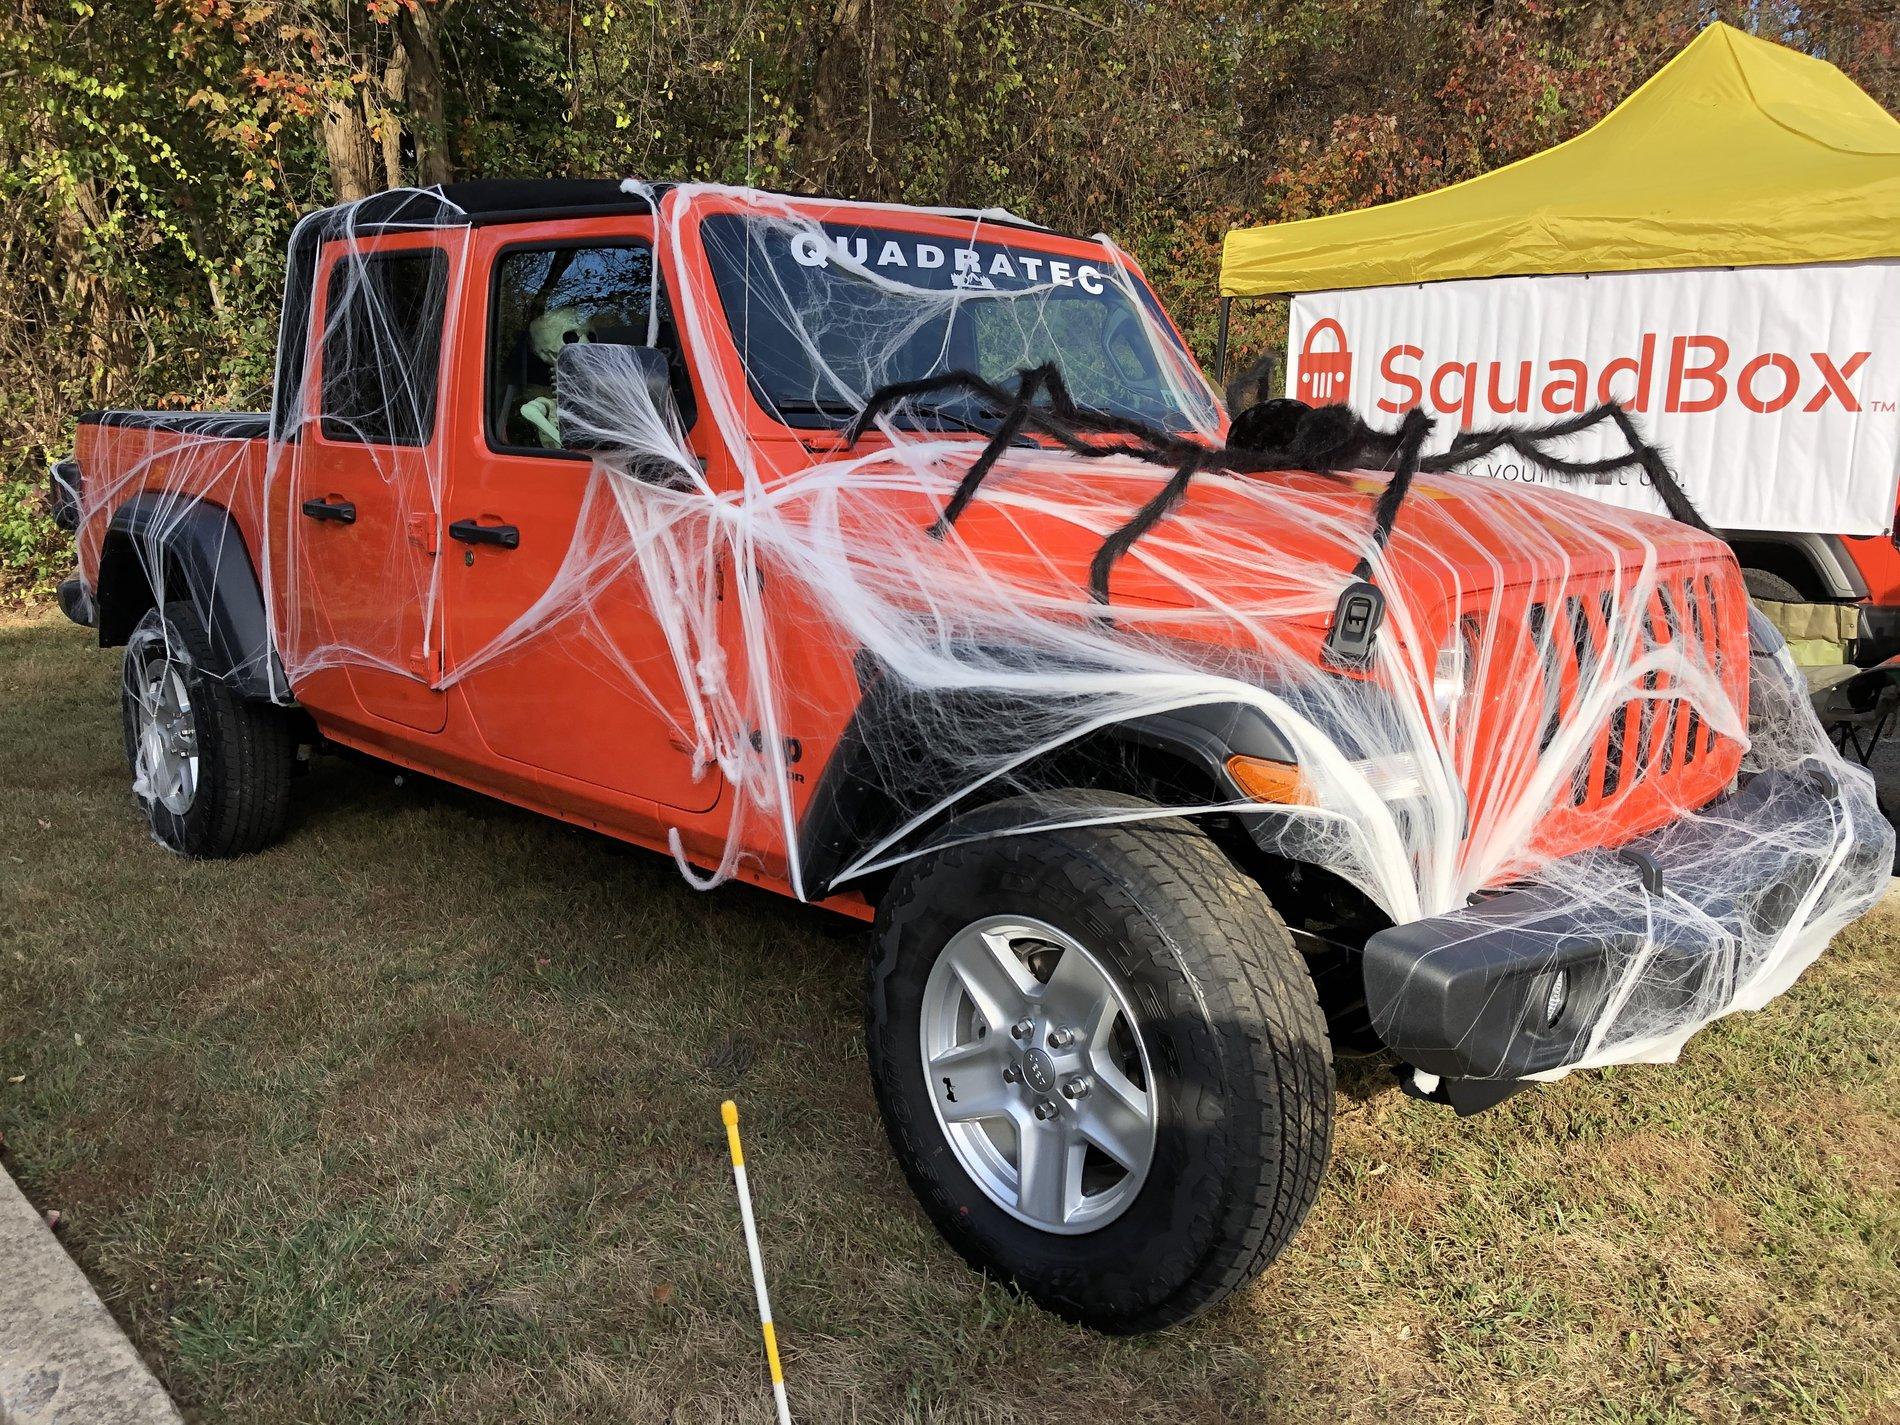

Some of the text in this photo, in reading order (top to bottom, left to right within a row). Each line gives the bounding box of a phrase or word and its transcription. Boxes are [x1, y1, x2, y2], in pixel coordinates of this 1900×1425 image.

[790, 232, 1105, 295] QUADRATEC
[1376, 333, 1895, 429] SquadBox TM
